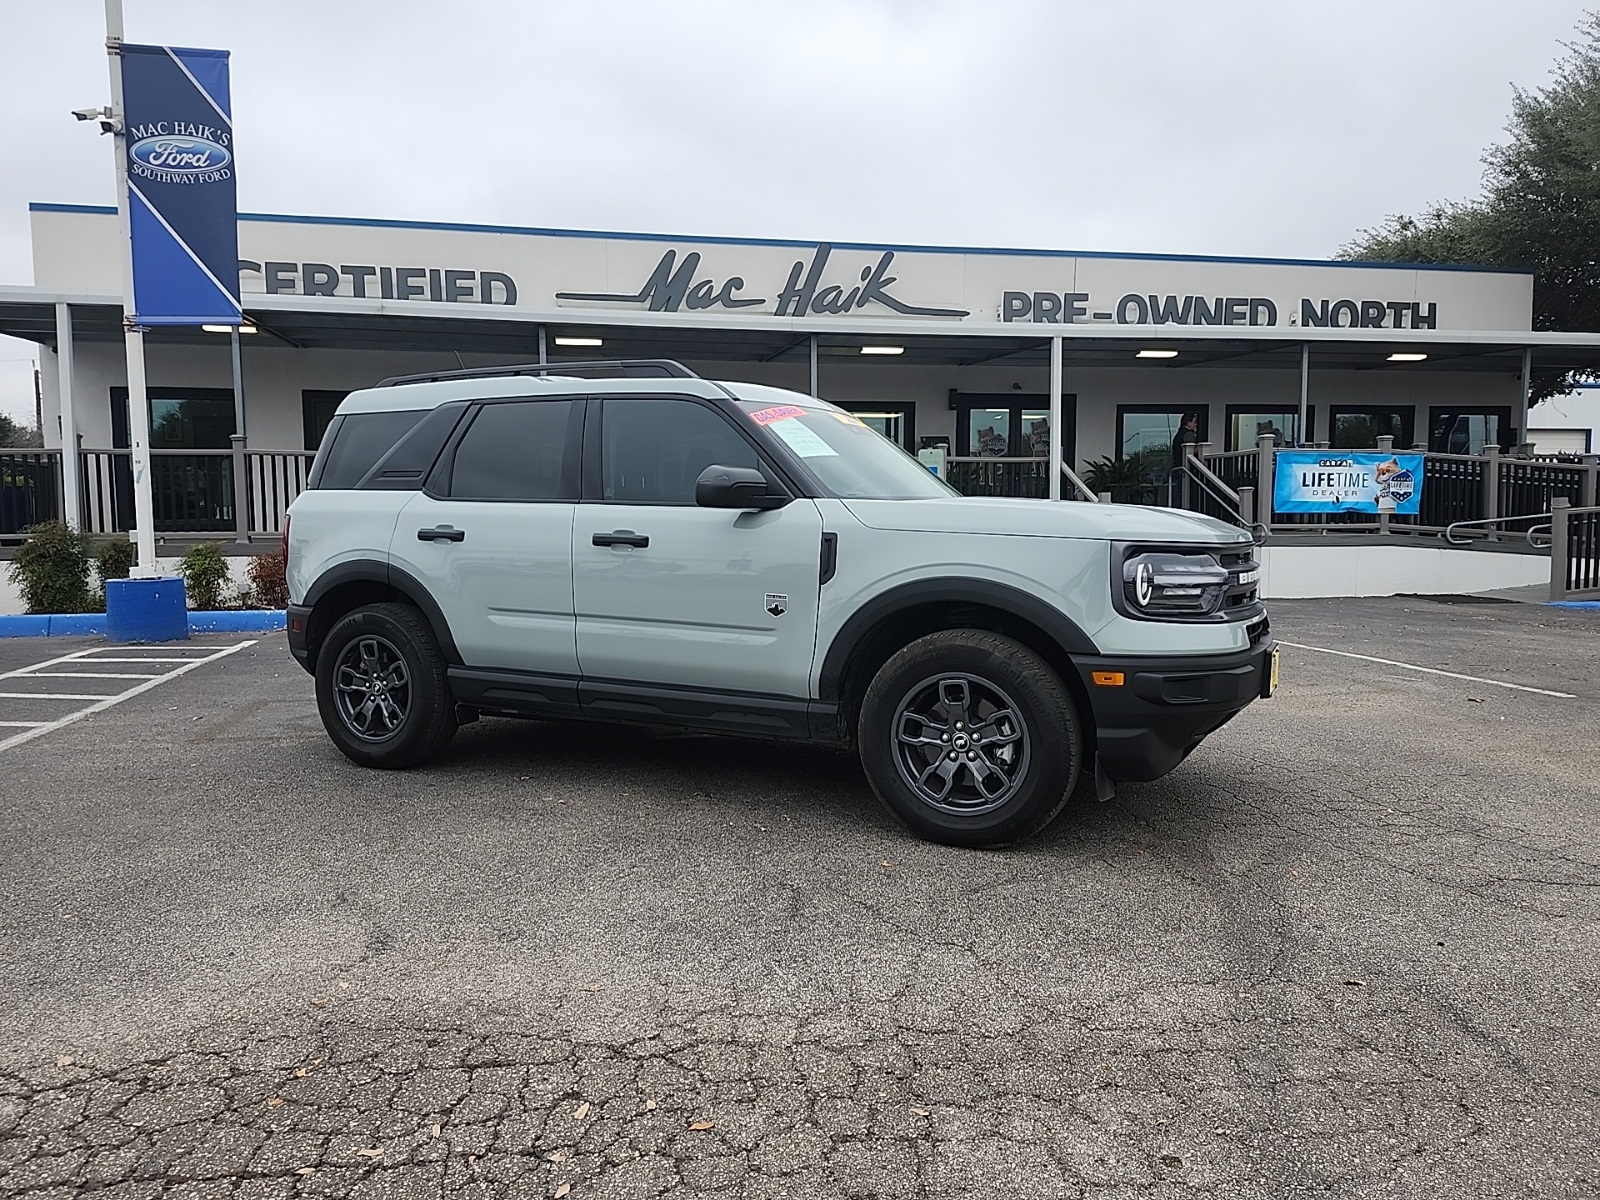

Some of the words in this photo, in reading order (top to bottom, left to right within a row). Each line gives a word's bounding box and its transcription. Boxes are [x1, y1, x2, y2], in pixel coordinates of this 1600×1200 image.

[130, 121, 169, 140] MAC
[173, 121, 231, 146] HAIK'S
[149, 141, 211, 167] Ford
[131, 163, 196, 184] SOUTHWAY
[199, 168, 231, 183] FORD
[610, 248, 766, 313] Mac
[773, 242, 955, 317] Haik
[1003, 291, 1278, 326] PRE-OWNED
[1301, 298, 1438, 329] NORTH
[1301, 472, 1370, 488] LIFETIME
